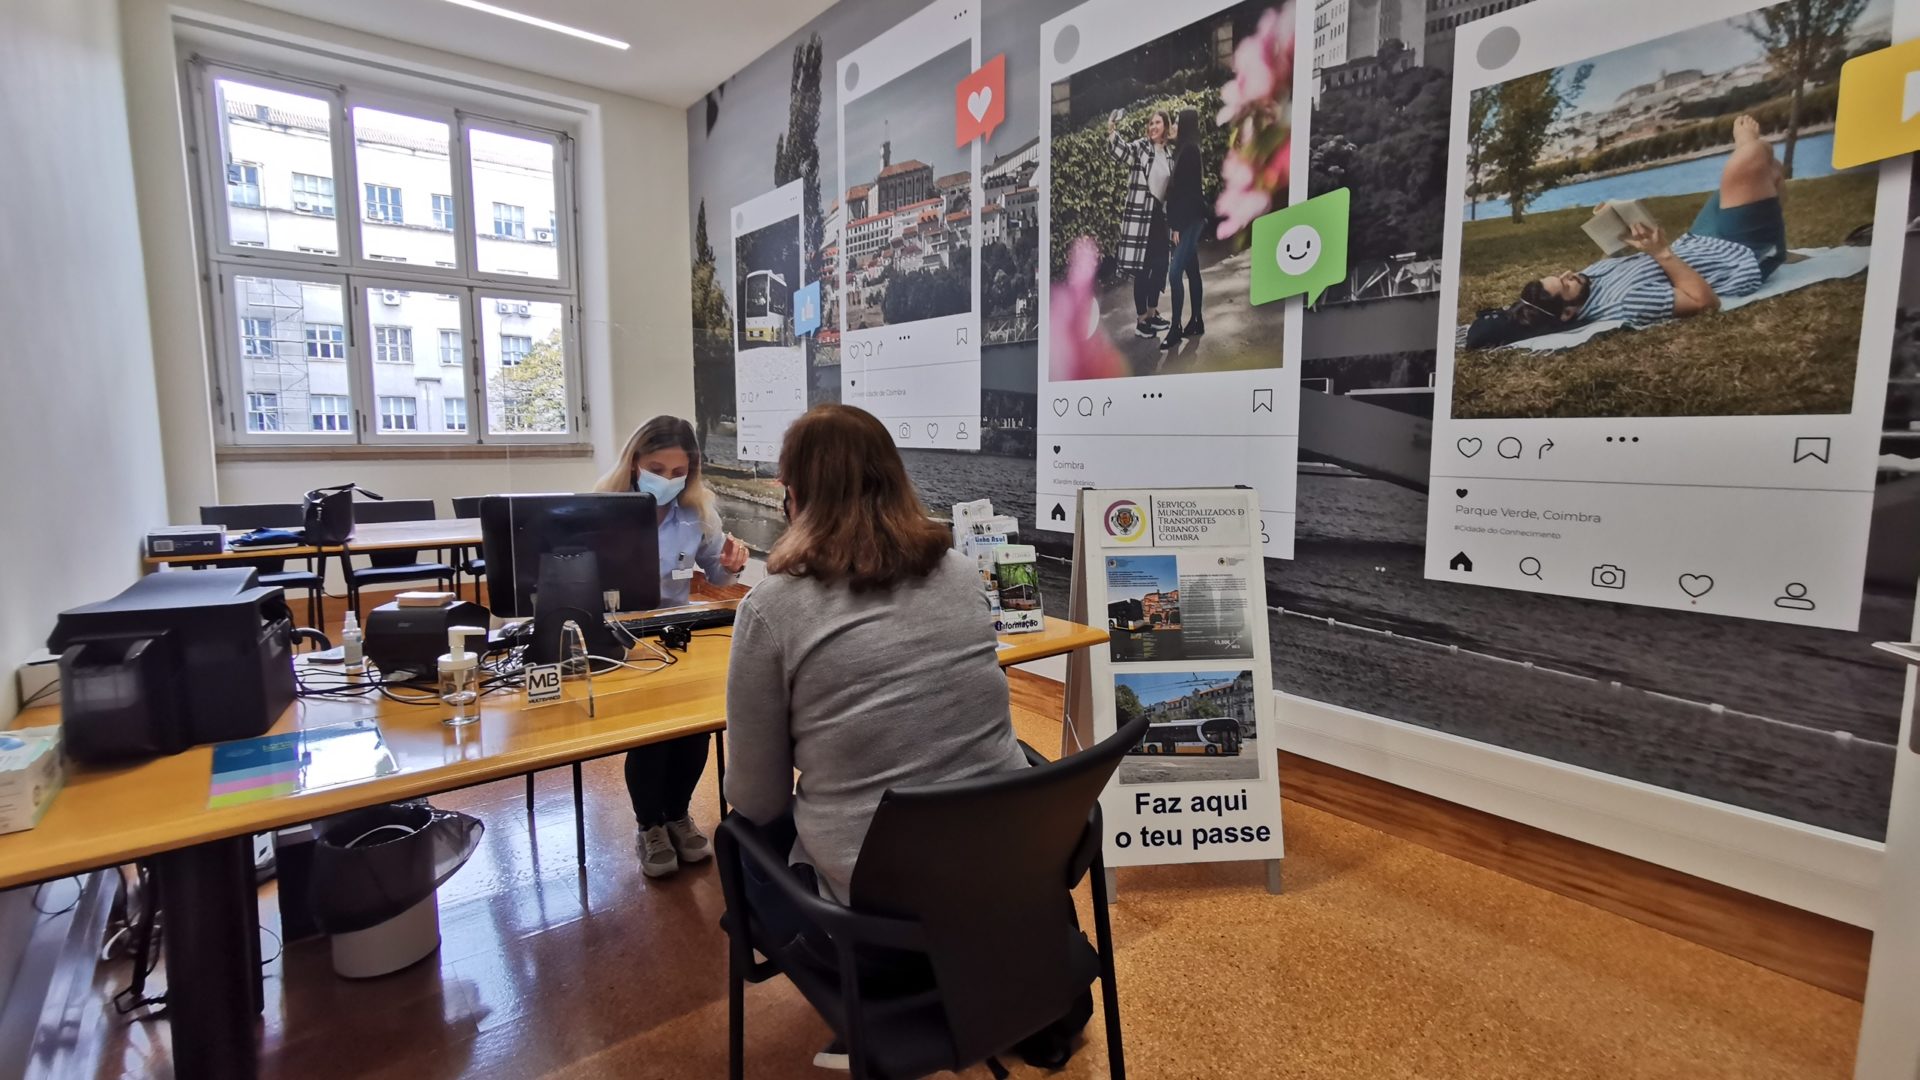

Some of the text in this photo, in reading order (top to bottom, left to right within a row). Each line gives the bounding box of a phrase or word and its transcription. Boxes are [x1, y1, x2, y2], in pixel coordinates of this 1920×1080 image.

[1053, 460, 1085, 470] Coimbra
[1157, 500, 1197, 509] SERVIÇOS
[1157, 508, 1236, 517] MUNICIPALIZADOS
[1455, 504, 1602, 523] Parque Verde, Coimbra
[1157, 516, 1217, 525] TRANSPORTES
[1158, 525, 1200, 533] URBANOS
[1499, 527, 1562, 540] Conhecimento
[1158, 533, 1200, 541] COIMBRA
[528, 672, 560, 690] MB
[1136, 789, 1248, 817] Faz aqui
[1115, 824, 1271, 850] o teu passe
